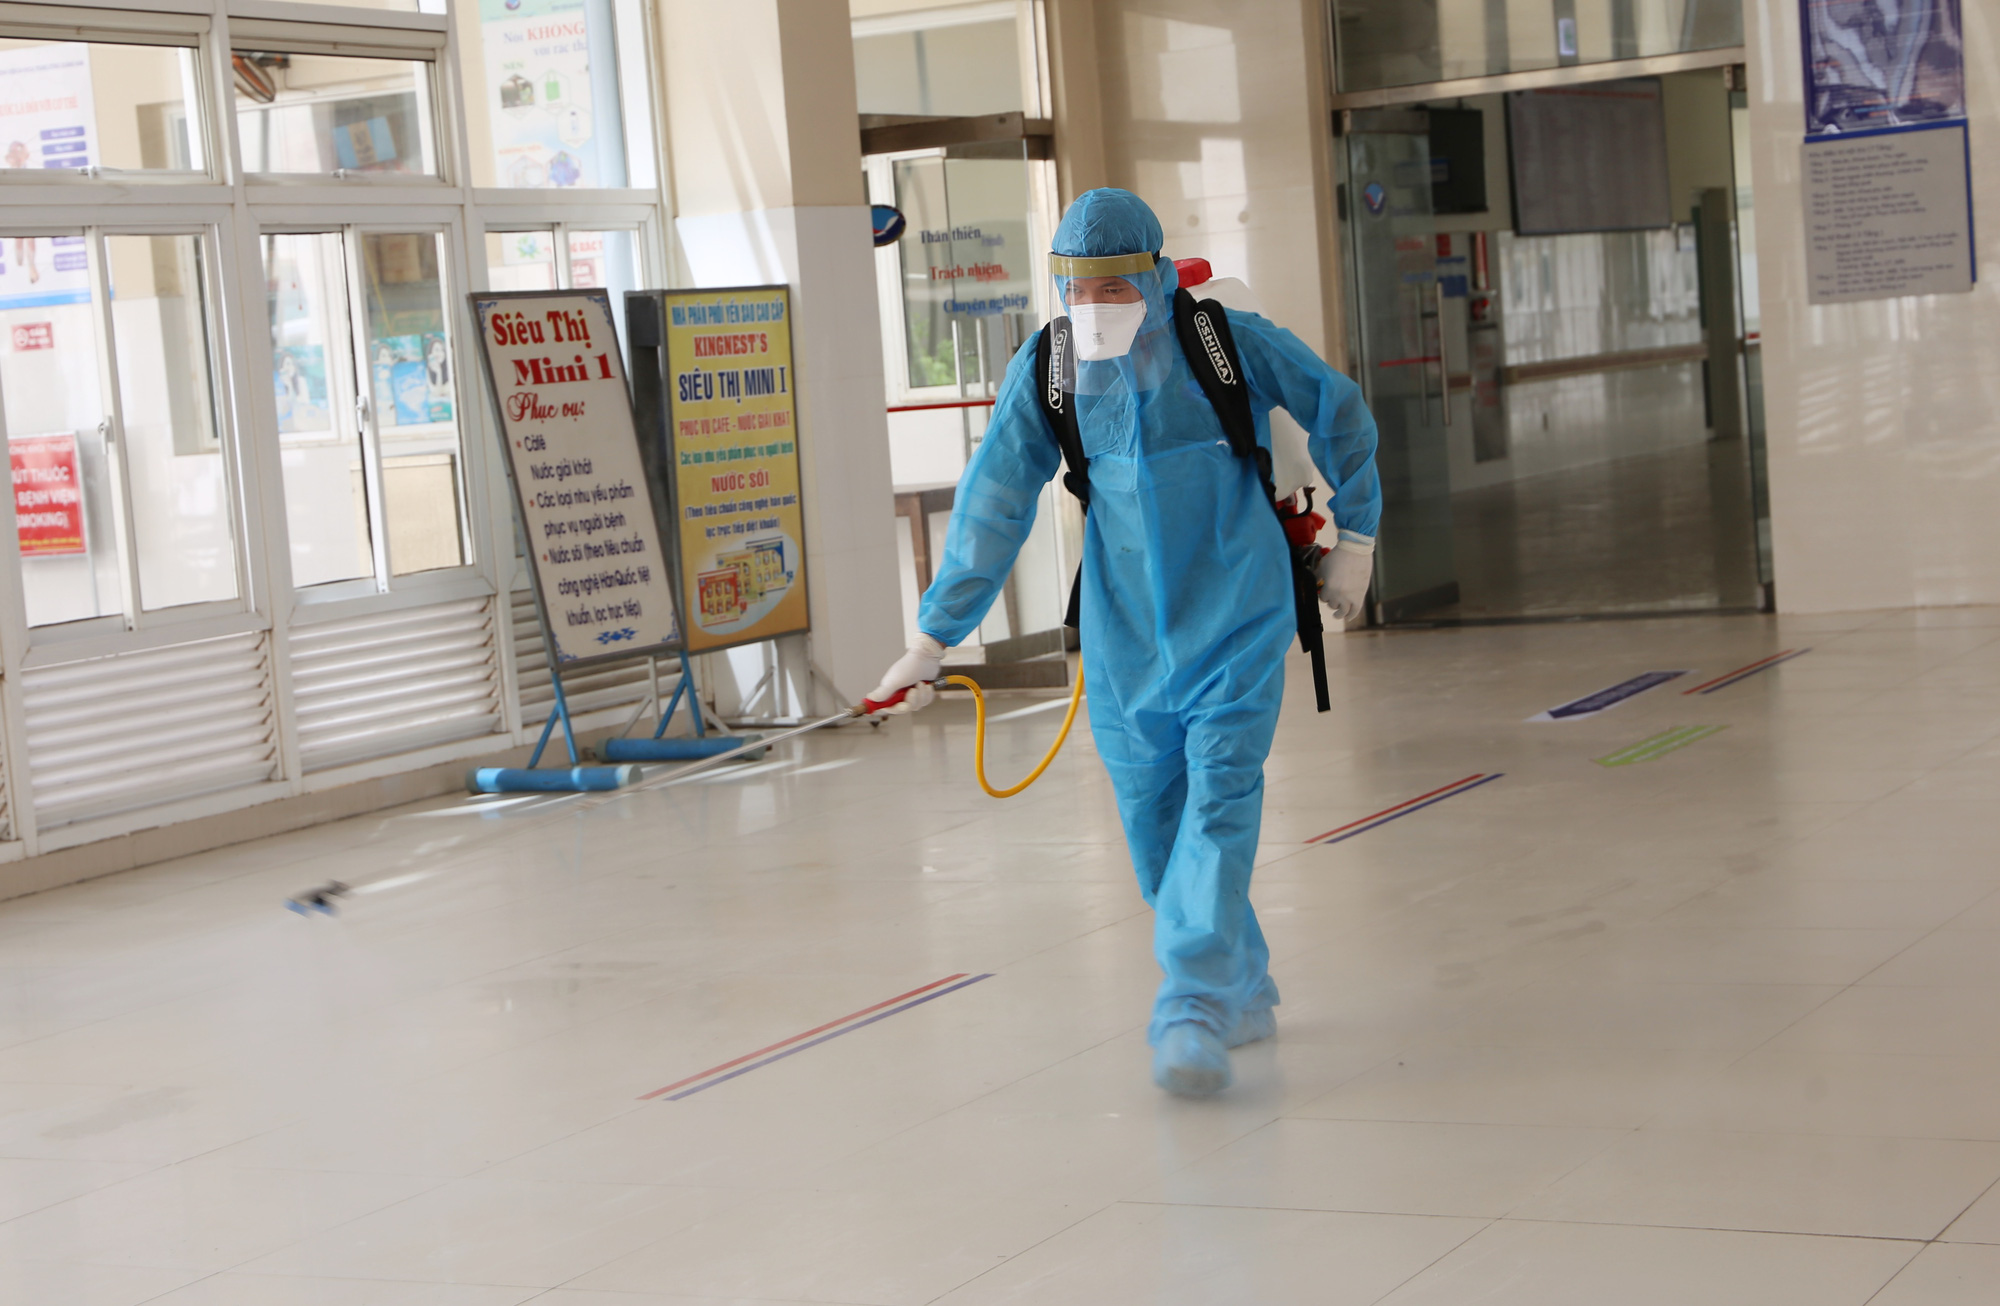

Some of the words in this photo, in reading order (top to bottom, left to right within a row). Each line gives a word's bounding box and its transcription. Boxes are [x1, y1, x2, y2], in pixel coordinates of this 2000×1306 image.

[929, 264, 964, 281] Trách
[943, 298, 986, 316] Chuyên
[989, 294, 1028, 314] nghiệp
[491, 311, 545, 346] Siêu
[546, 309, 592, 349] Thị
[694, 333, 768, 357] KINGNEST'S
[1197, 315, 1229, 379] OSHIMA
[511, 354, 590, 386] Mini
[593, 352, 616, 380] 1
[1050, 332, 1064, 402] OSHIMA
[678, 367, 713, 402] SIÊU
[718, 371, 741, 404] THỊ
[744, 368, 775, 397] MINI
[779, 366, 787, 393] I
[506, 392, 558, 424] Phục
[530, 462, 555, 481] Nước
[555, 458, 573, 482] giải
[572, 458, 593, 476] khát
[712, 471, 745, 493] NƯỚC
[749, 467, 770, 488] SÔI
[536, 491, 556, 509] Các
[556, 489, 573, 509] loại
[591, 483, 608, 505] yếu
[609, 479, 635, 504] phẩm
[544, 519, 566, 539] phục
[567, 520, 579, 537] vụ
[579, 513, 604, 536] người
[604, 511, 627, 532] bệnh
[620, 531, 646, 554] chuẩn
[558, 578, 579, 597] công
[579, 573, 600, 595] nghệ
[593, 606, 608, 625] lọc
